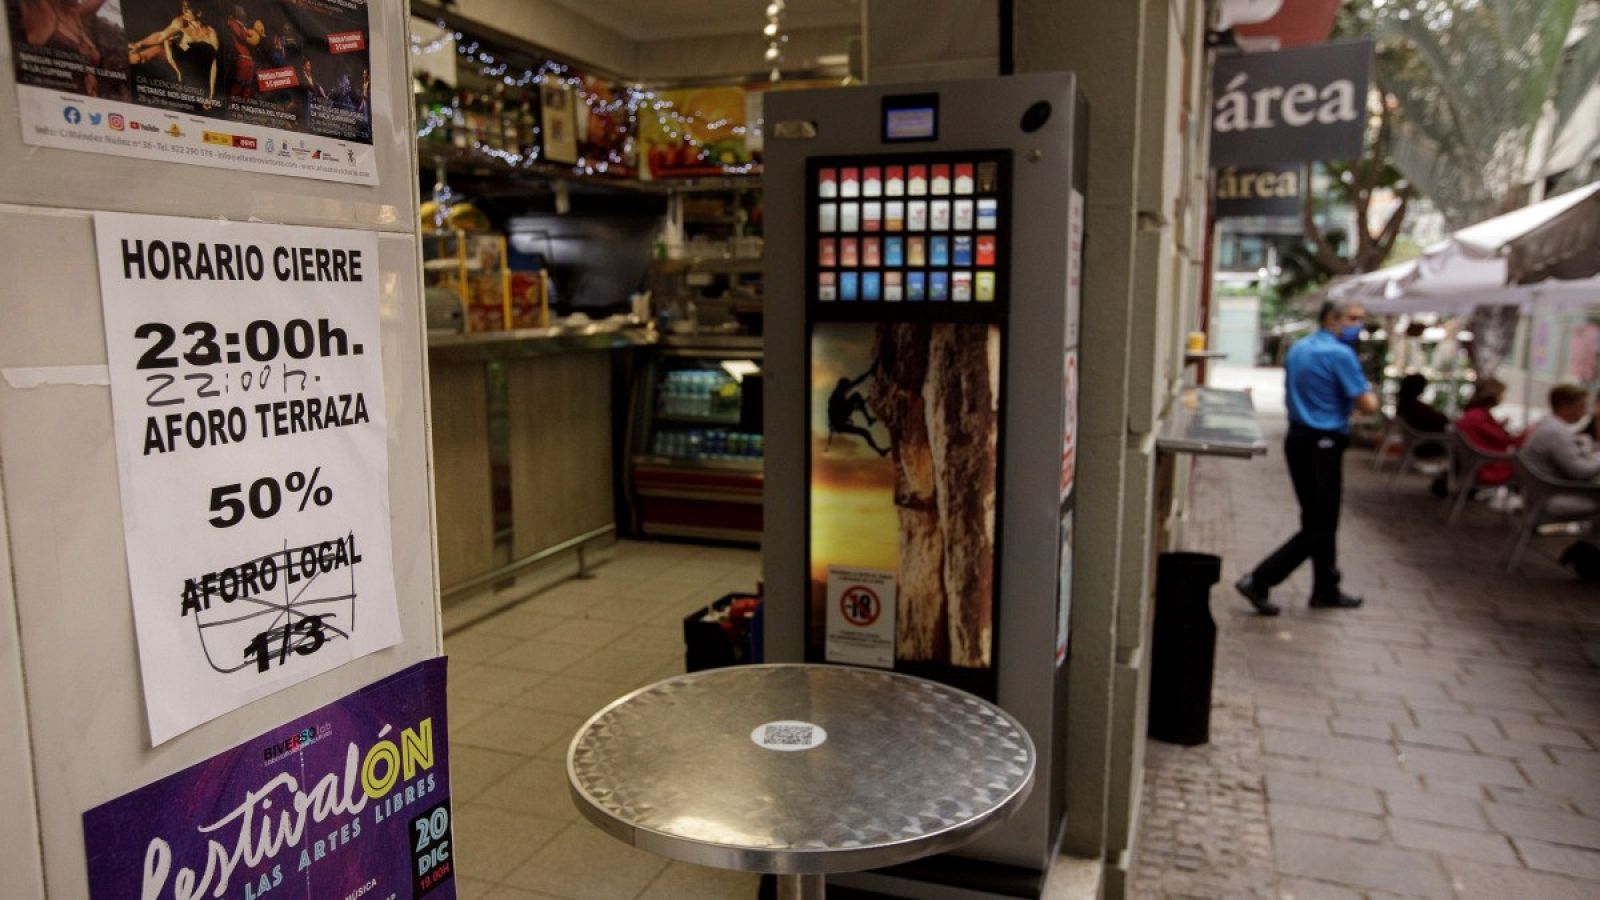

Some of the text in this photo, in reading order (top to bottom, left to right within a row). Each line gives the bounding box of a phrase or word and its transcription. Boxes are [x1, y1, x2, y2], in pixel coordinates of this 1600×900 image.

[1214, 72, 1358, 133] área
[1215, 165, 1298, 199] área
[121, 238, 363, 282] HORARIO CIERRE
[134, 318, 364, 370] 23:00h.
[143, 392, 369, 456] AFORO TERRAZA
[208, 466, 333, 529] 50%
[181, 533, 362, 617] AFORO LOCAL
[244, 615, 326, 673] 1/3
[244, 774, 436, 900] LAS ARTES LIBRES
[415, 807, 449, 853] 20
[418, 840, 449, 876] DIC
